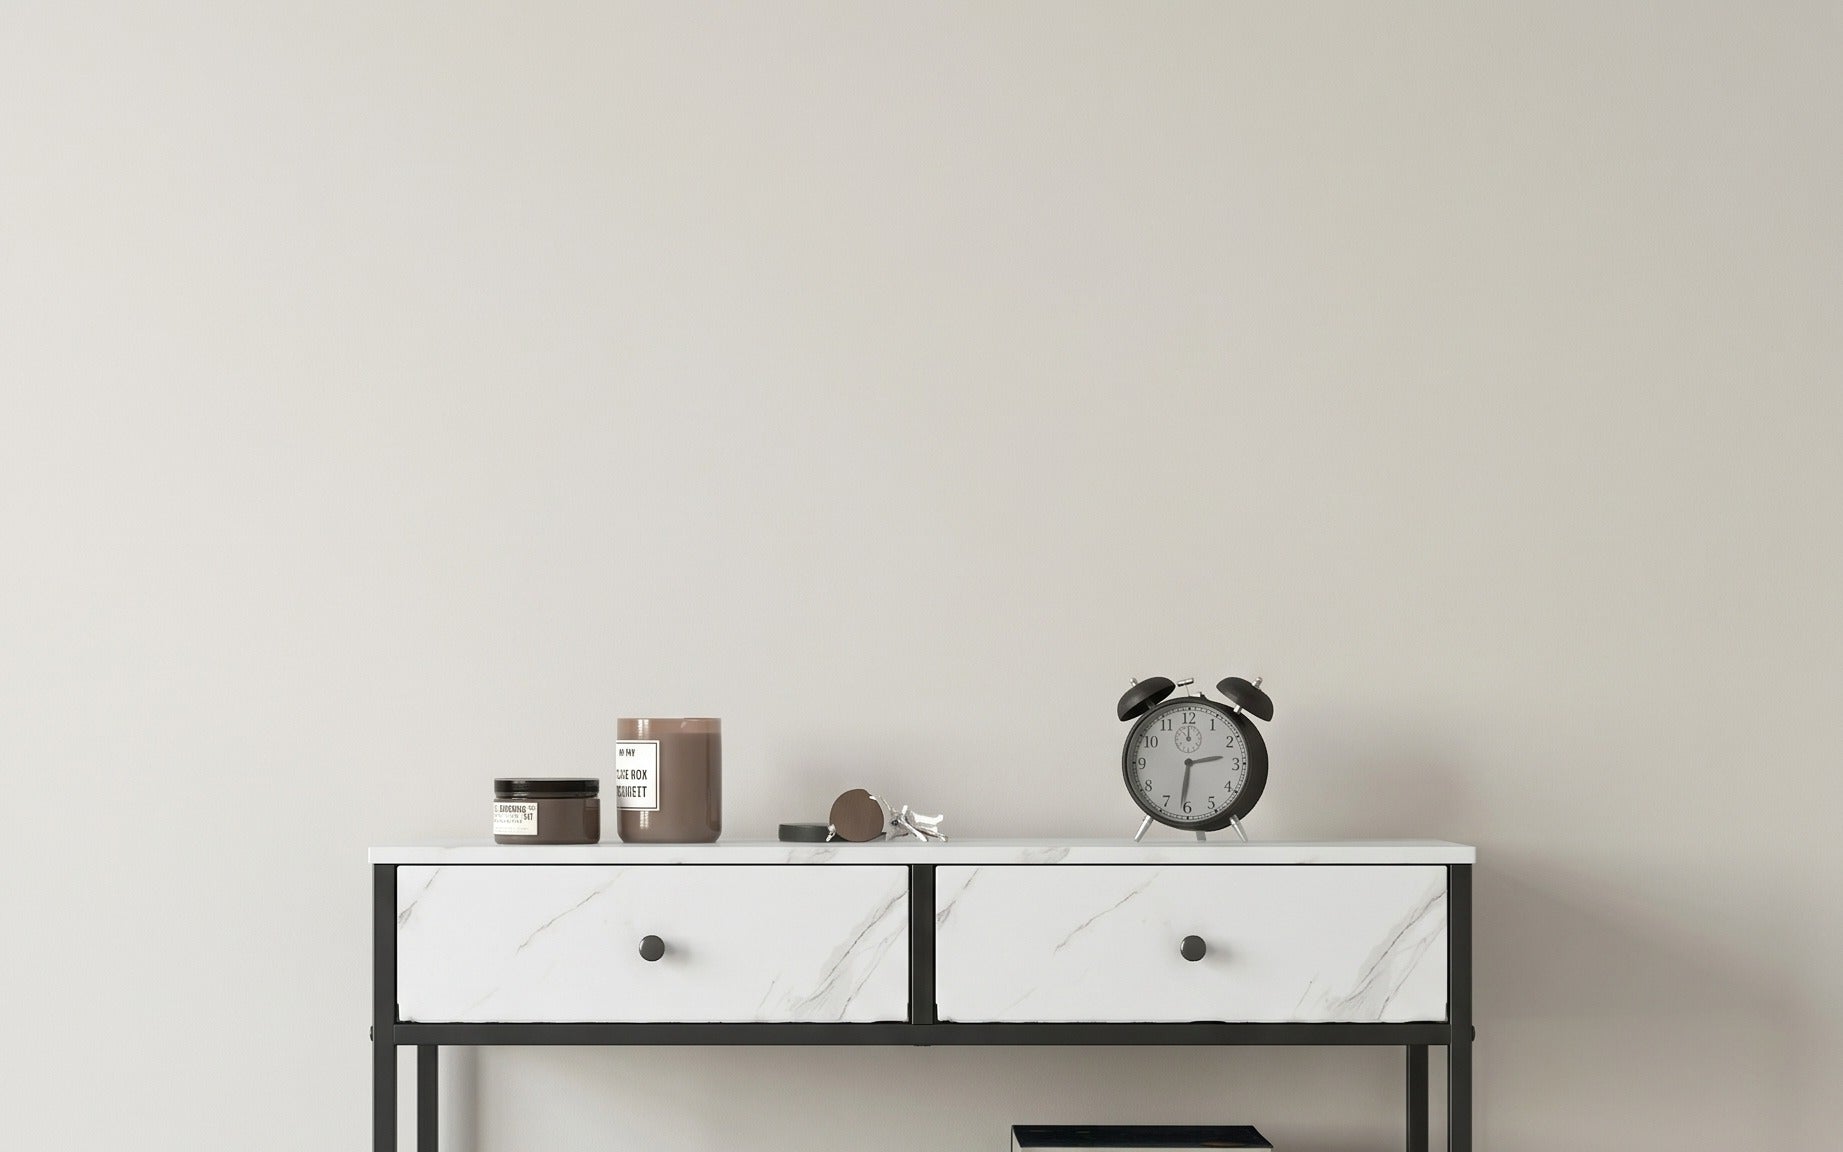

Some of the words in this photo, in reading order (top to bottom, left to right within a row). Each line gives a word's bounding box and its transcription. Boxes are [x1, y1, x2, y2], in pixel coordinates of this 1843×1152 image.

[1160, 719, 1173, 731] 11
[1182, 712, 1196, 725] 12
[1210, 719, 1216, 731] 1
[1144, 735, 1158, 748] 10
[1225, 736, 1234, 748] 2
[1138, 757, 1146, 770] 9
[1232, 757, 1240, 771] 3
[1144, 779, 1153, 792] 8
[1223, 780, 1232, 793] 4
[1162, 795, 1171, 807] 7
[1182, 801, 1192, 814] 6
[1207, 796, 1216, 810] 5
